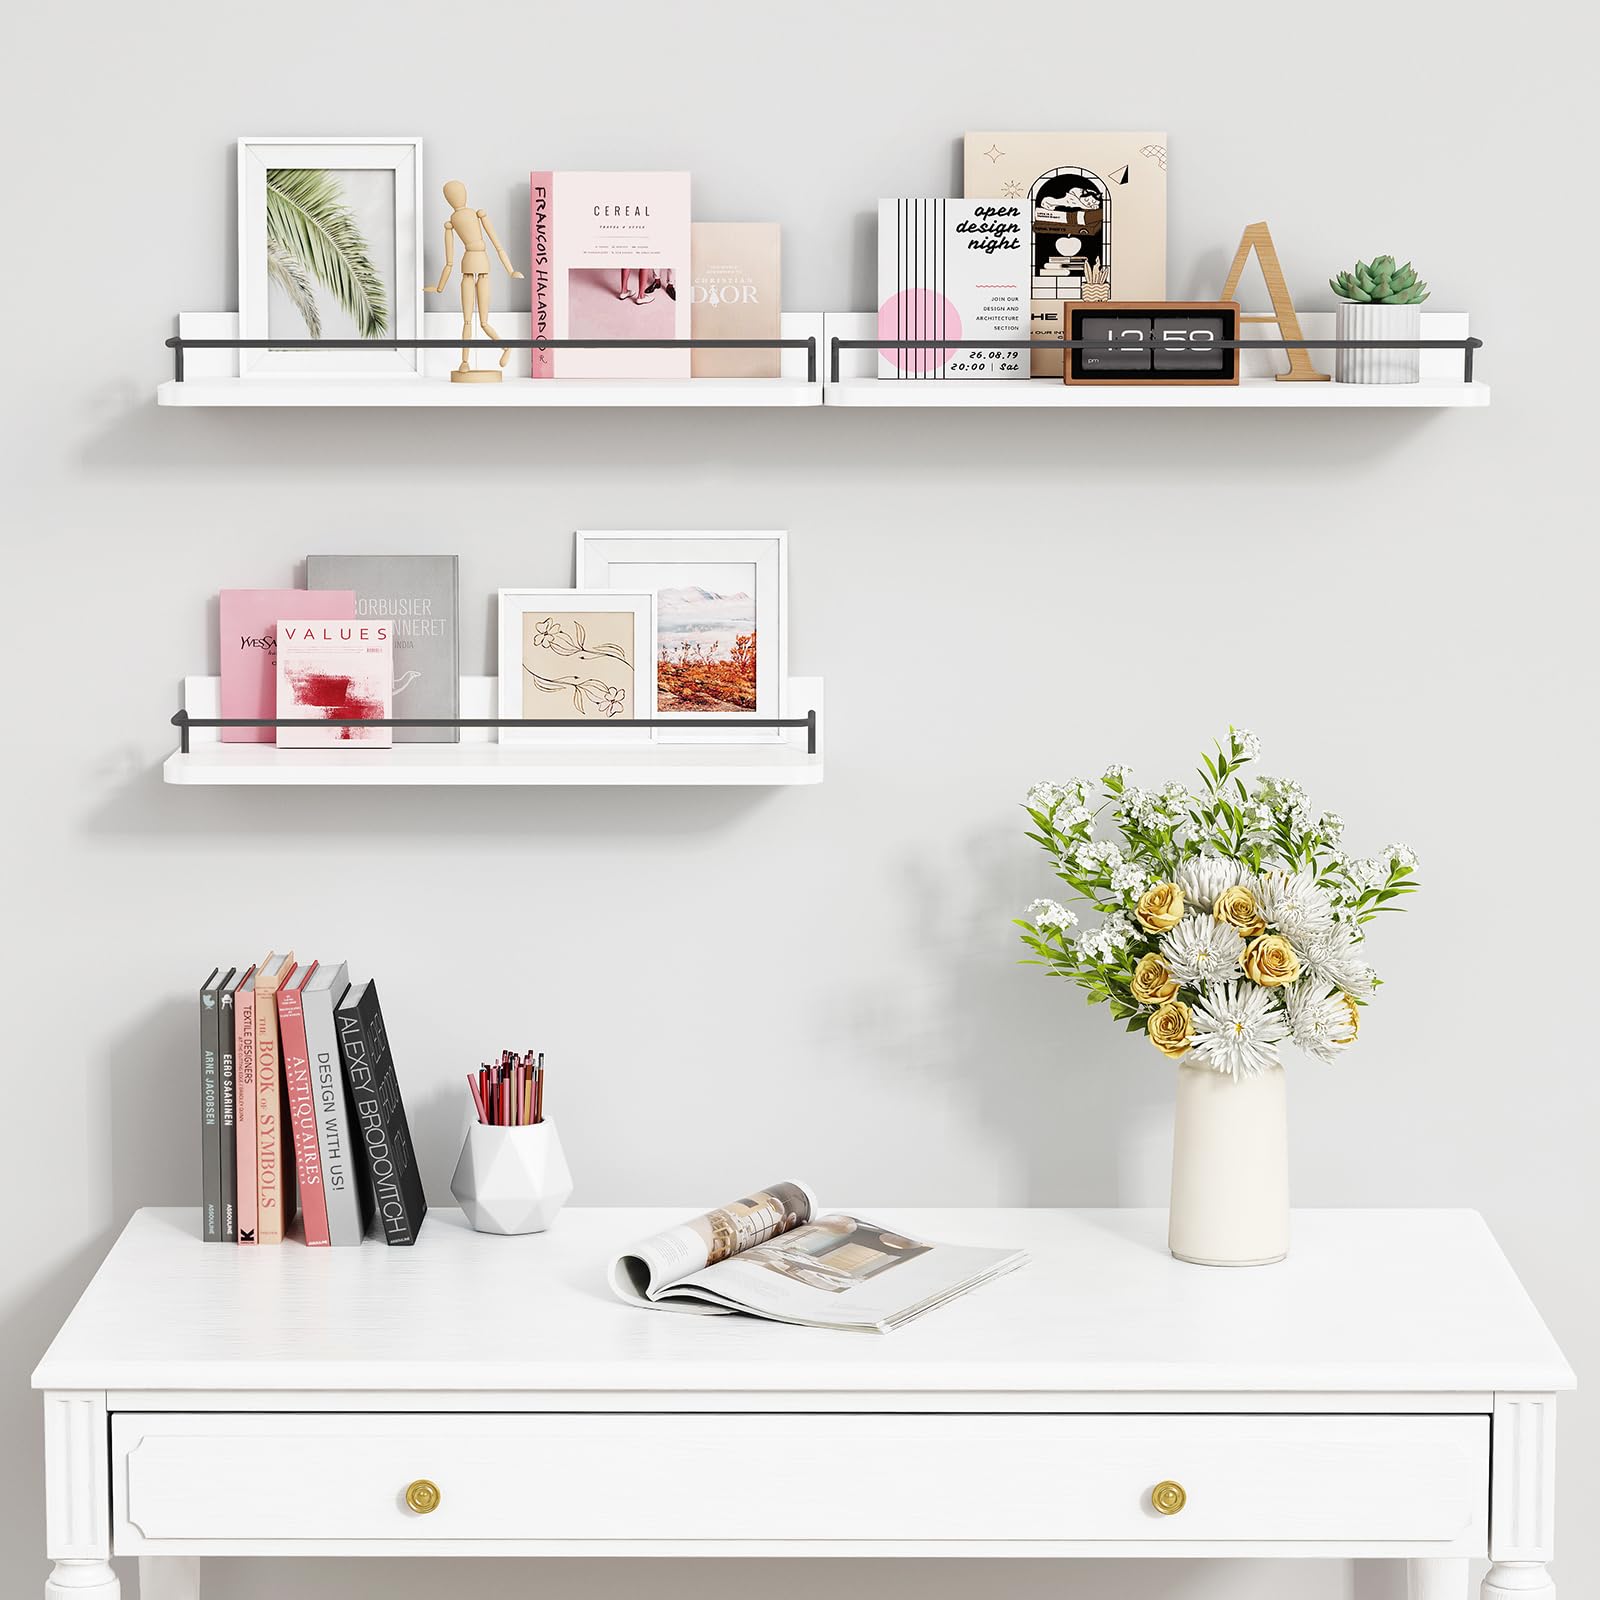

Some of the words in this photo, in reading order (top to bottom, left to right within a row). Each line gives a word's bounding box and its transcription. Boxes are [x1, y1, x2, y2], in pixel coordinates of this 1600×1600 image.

[535, 187, 548, 265] FRANÇOIS
[594, 206, 650, 217] CEREAL
[974, 206, 1021, 221] open
[956, 220, 1021, 238] design
[967, 236, 1021, 254] night
[951, 363, 985, 371] 20:00
[999, 363, 1020, 371] Sat
[354, 598, 432, 616] ORBUSIER
[285, 628, 387, 640] VALUES
[394, 641, 414, 649] INDIA
[243, 1005, 253, 1037] TEXTILE
[204, 1050, 214, 1075] ARNE
[223, 1054, 233, 1077] EERO
[243, 1039, 253, 1084] DESIGNERS
[260, 1041, 274, 1093] BOOK
[317, 1052, 336, 1113] DESIGN
[205, 1080, 215, 1125] JACOBSEN
[223, 1081, 233, 1126] SAARINEN
[260, 1098, 267, 1109] OF
[287, 1057, 295, 1091] PARIS
[296, 1133, 306, 1185] MARKETS
[293, 1056, 320, 1185] ANTIQUAIRES
[338, 1016, 375, 1093] ALEXEY
[358, 1099, 407, 1234] BRODOVITCH
[325, 1117, 341, 1159] WITH
[260, 1114, 276, 1208] SYMBOLS
[330, 1164, 345, 1191] US!
